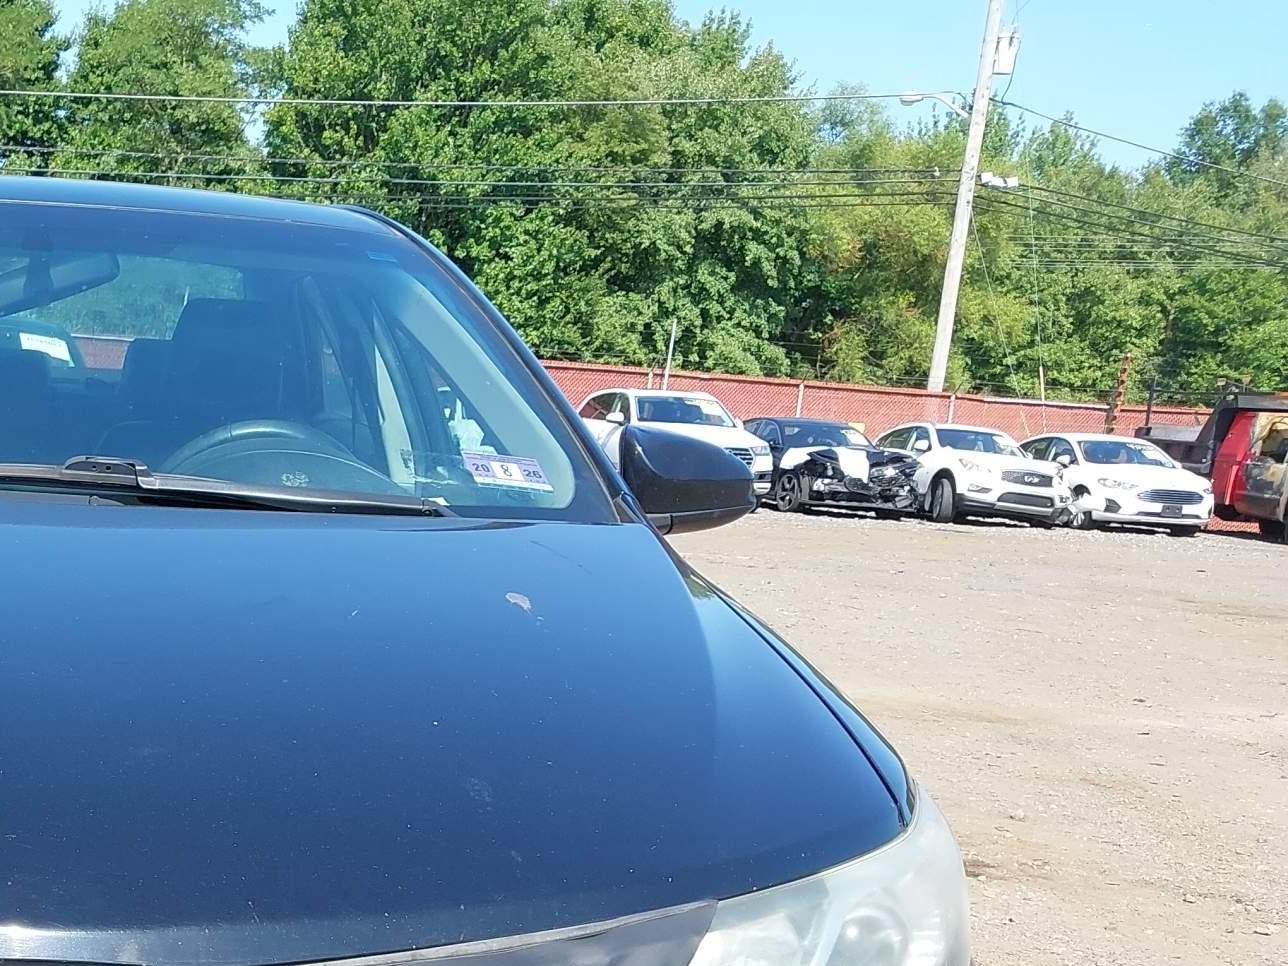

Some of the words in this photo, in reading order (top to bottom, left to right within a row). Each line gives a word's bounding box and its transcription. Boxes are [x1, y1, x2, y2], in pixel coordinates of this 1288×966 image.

[472, 462, 491, 473] 20
[500, 464, 512, 477] 8
[523, 469, 542, 479] 26
